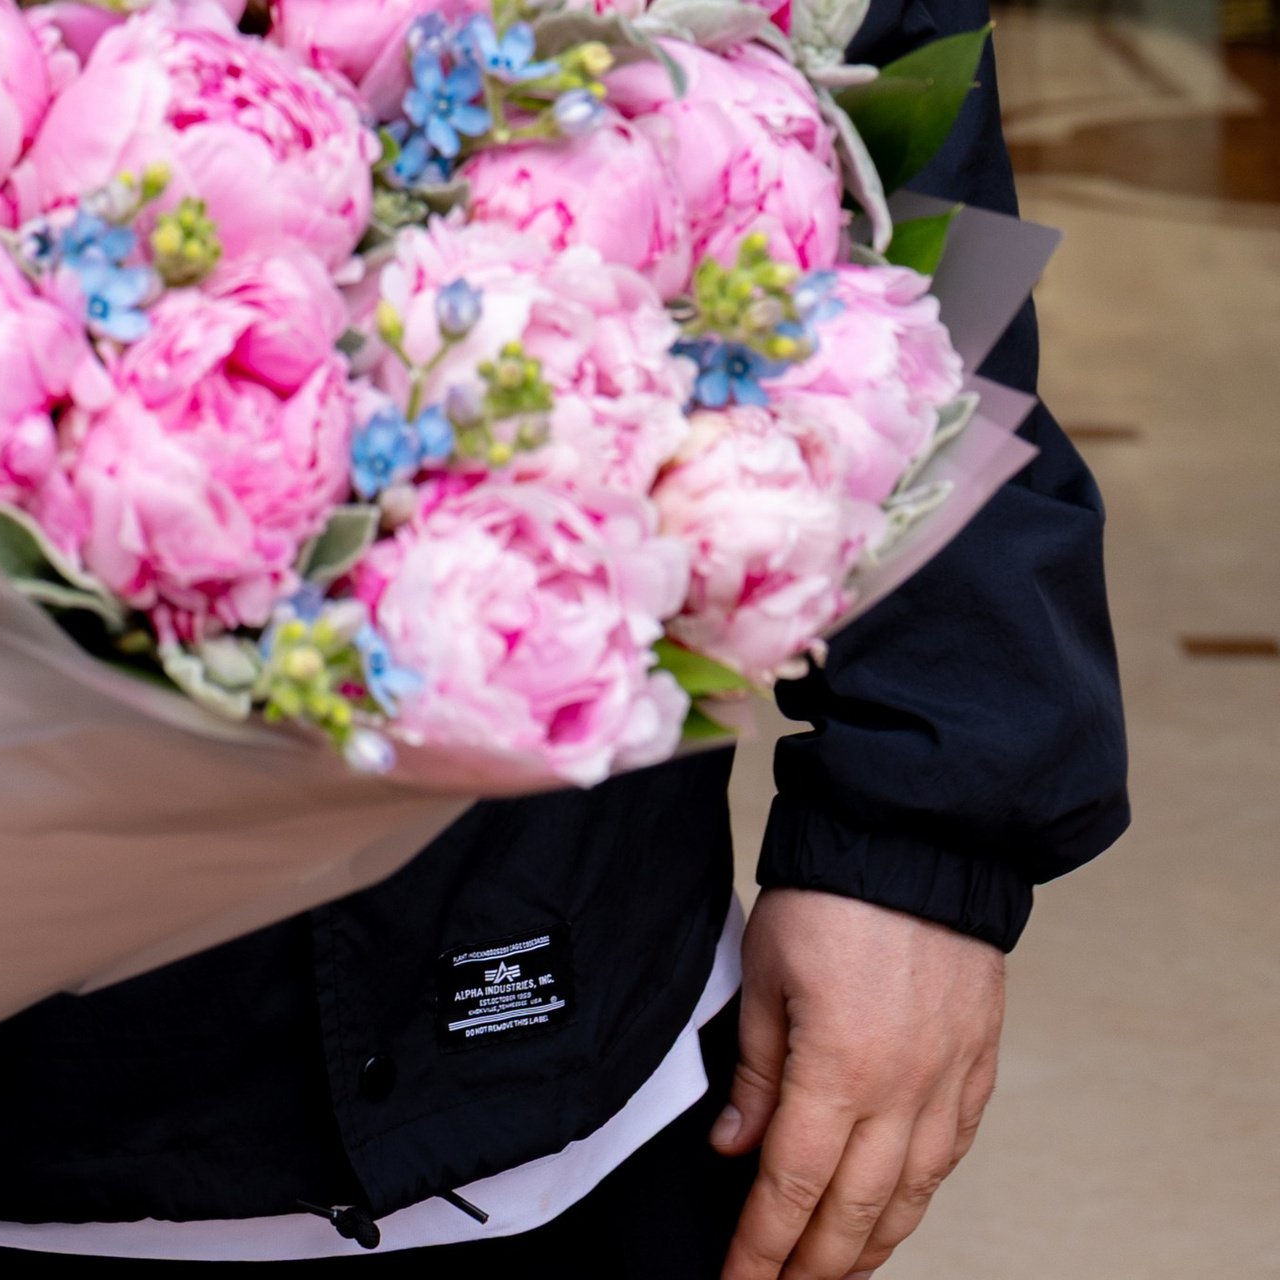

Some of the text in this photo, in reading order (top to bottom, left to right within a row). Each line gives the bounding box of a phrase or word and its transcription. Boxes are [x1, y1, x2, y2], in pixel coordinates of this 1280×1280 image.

[454, 973, 555, 1001] ALPHA INDUSTRIES, INC.
[465, 1028, 475, 1037] DO
[475, 1026, 488, 1035] NOT
[488, 1021, 514, 1033] REMOVE
[514, 1018, 529, 1027] THIS
